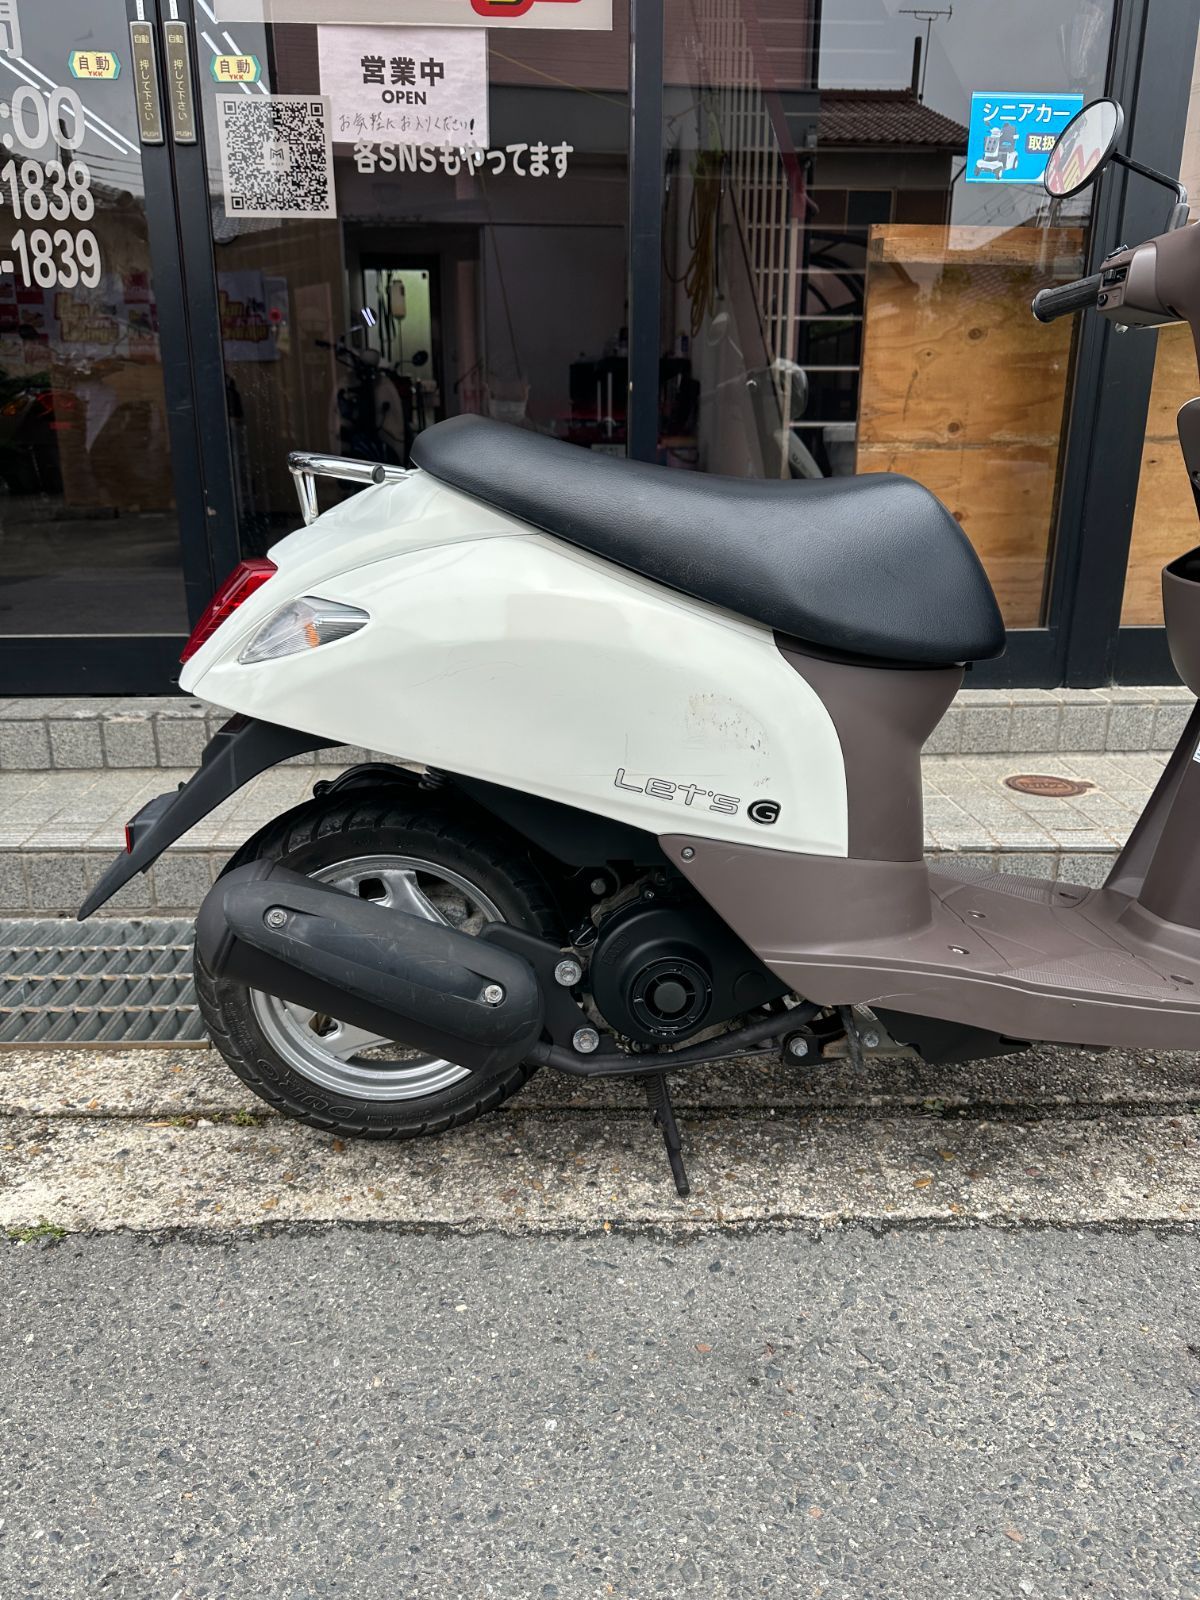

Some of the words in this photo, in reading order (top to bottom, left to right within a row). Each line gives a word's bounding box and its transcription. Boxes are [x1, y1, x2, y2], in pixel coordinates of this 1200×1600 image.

[134, 34, 150, 44] 自動
[168, 34, 184, 44] 自動
[78, 56, 110, 71] 自動
[219, 59, 251, 74] 自動
[360, 55, 446, 87] 営業中
[139, 59, 155, 121] 押して下さい
[173, 59, 188, 121] 押して下さい
[381, 90, 428, 106] OPEN
[982, 102, 1071, 123] シニアカー
[353, 140, 574, 179] 各SNSもやってます
[0, 160, 95, 221] 1838
[614, 768, 741, 815] Let's
[750, 801, 780, 823] G
